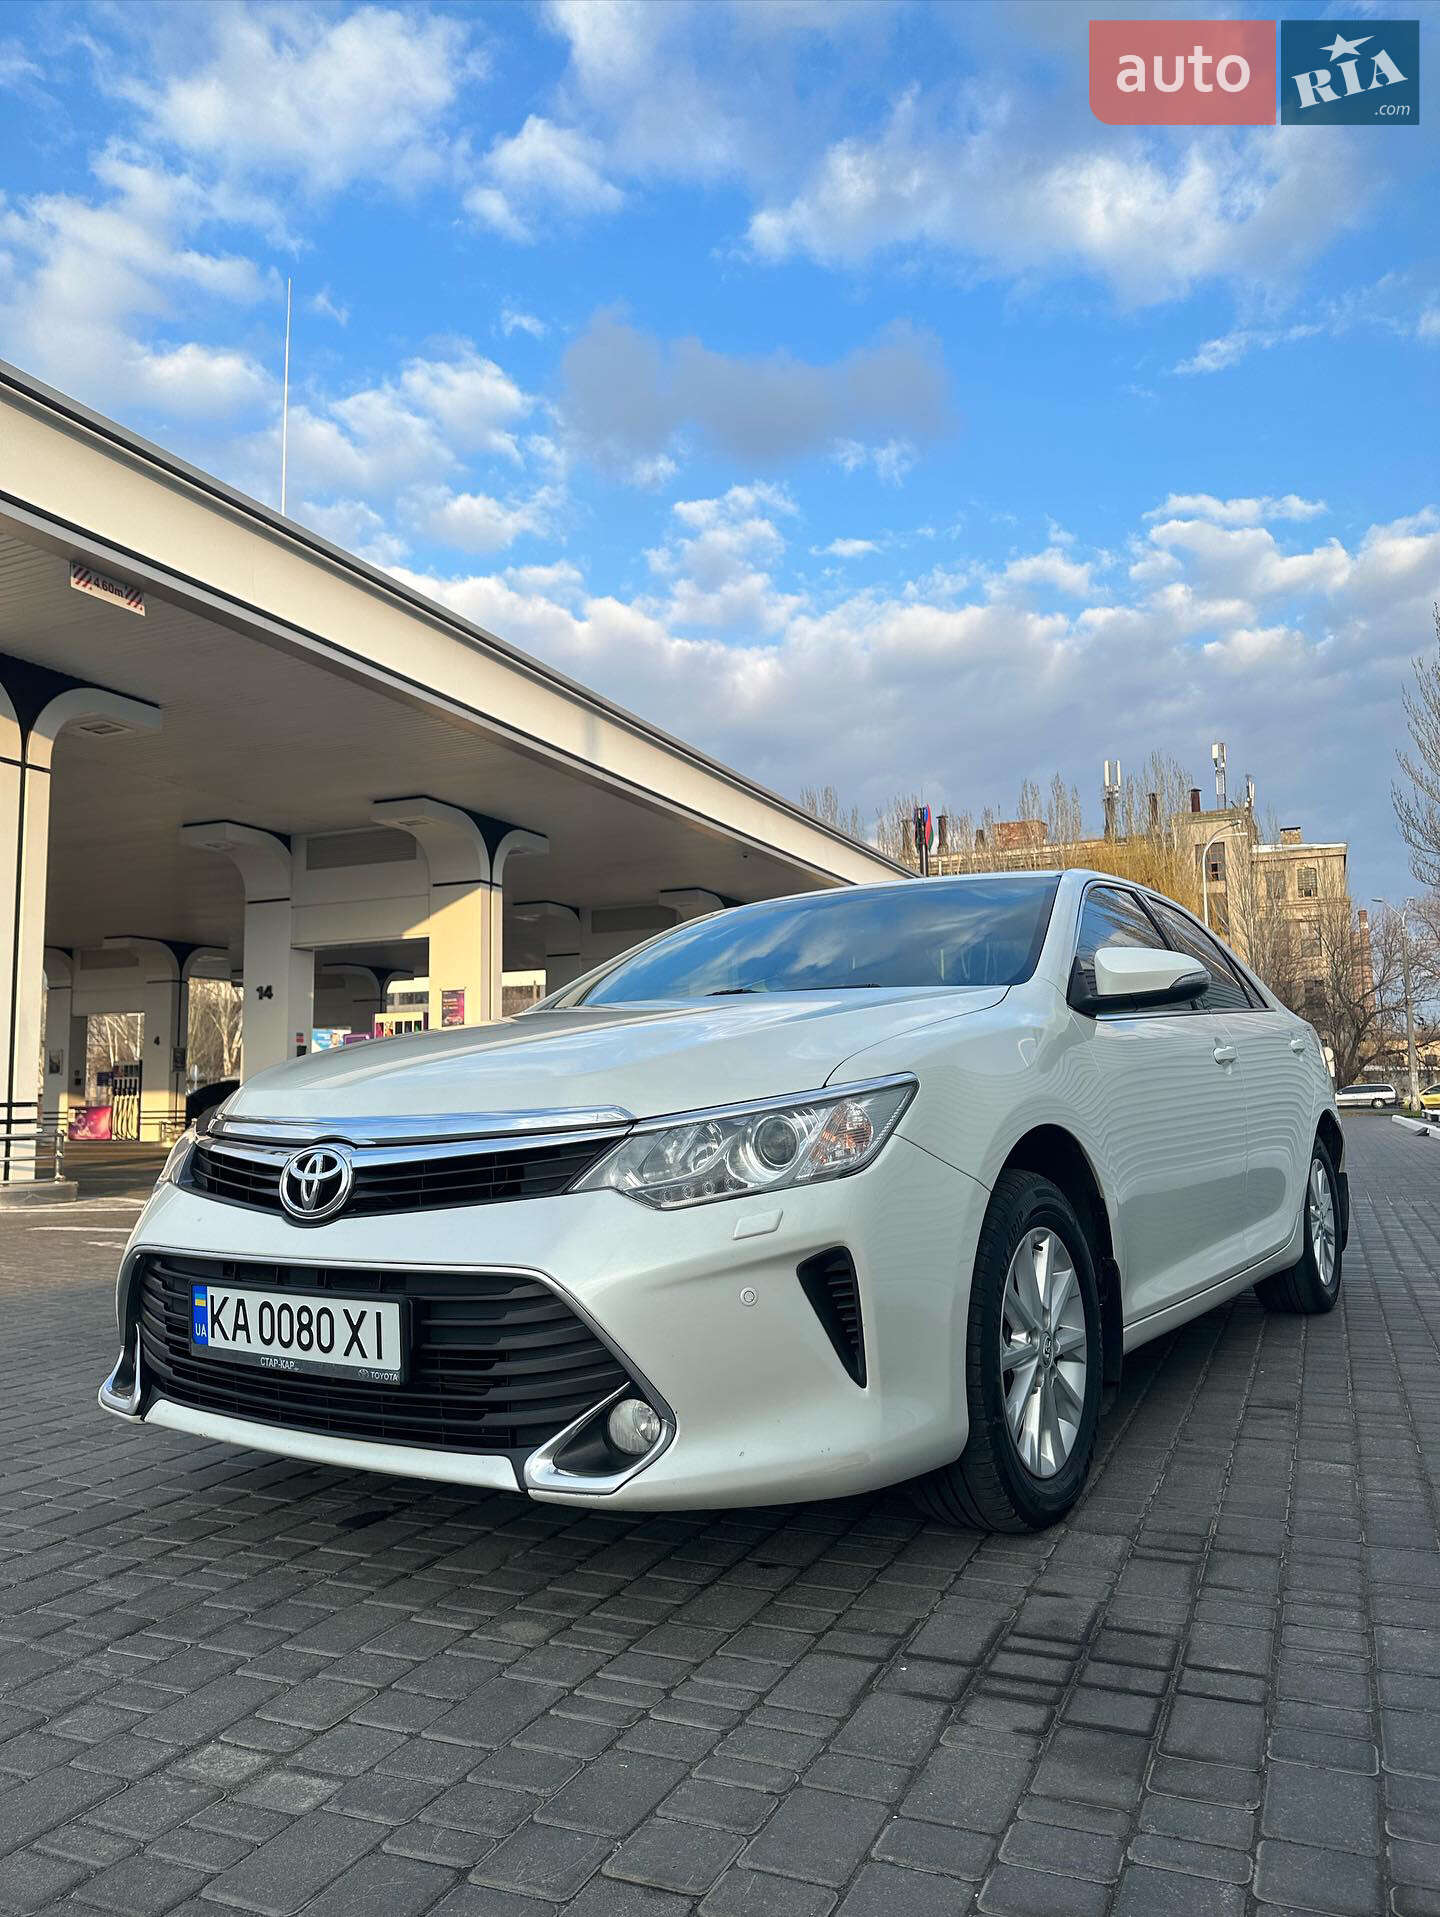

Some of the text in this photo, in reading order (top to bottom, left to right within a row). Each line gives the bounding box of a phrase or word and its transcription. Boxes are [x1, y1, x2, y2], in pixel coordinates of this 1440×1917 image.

[256, 985, 274, 1000] 14
[195, 1322, 207, 1338] UA
[370, 1371, 399, 1382] TOYOTA
